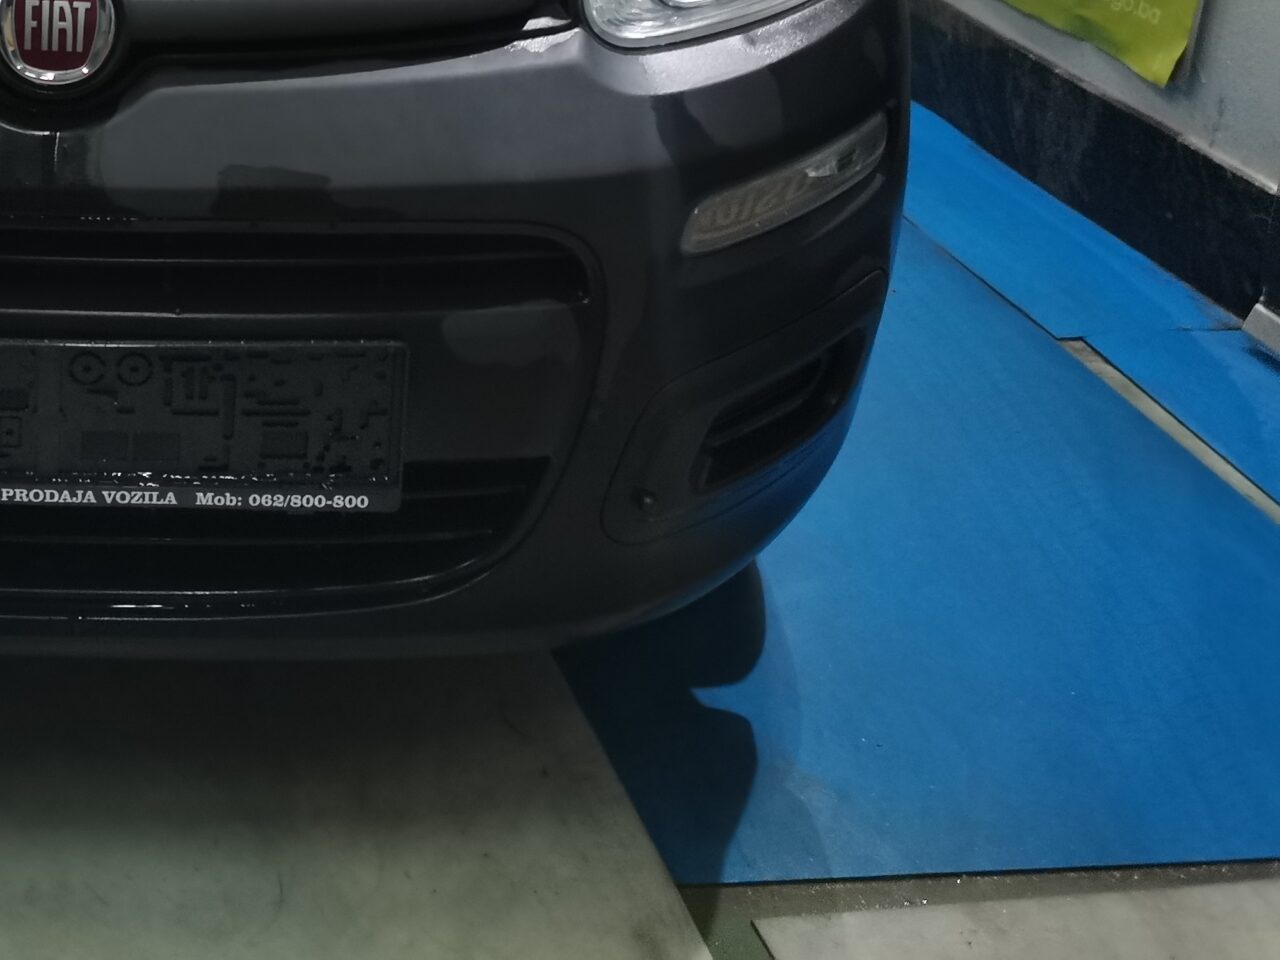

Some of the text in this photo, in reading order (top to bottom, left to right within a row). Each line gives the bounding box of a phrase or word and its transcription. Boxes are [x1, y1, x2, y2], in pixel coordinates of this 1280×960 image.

[0, 488, 97, 504] PRODAJA
[101, 490, 178, 506] VOZILA
[195, 492, 243, 507] Mob:
[248, 494, 369, 509] 062/800-800
